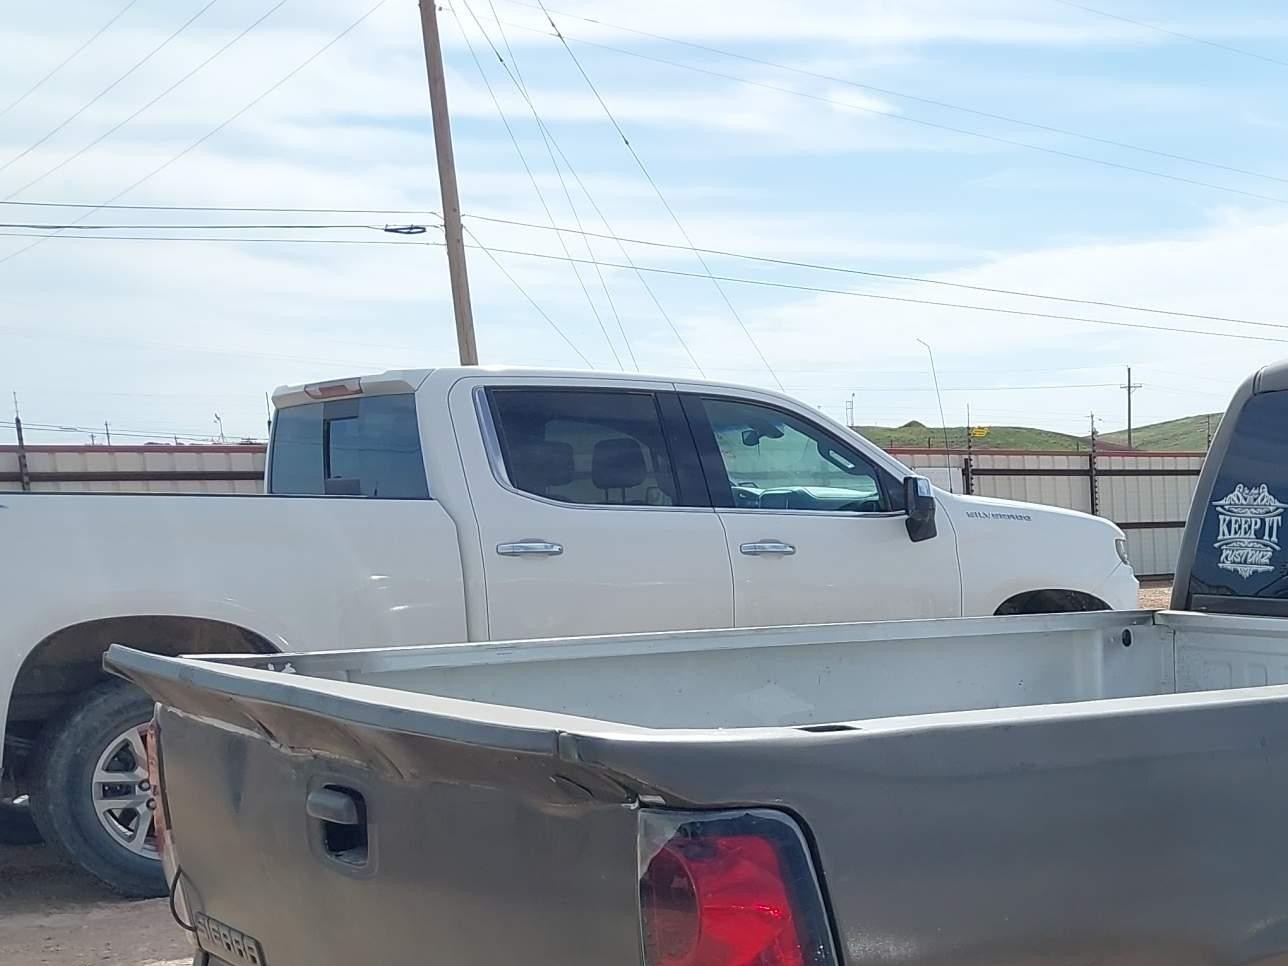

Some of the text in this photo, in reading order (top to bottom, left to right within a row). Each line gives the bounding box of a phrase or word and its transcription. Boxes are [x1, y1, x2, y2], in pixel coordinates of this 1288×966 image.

[1217, 514, 1282, 543] KEEP IT
[1220, 549, 1273, 564] KUSTOMZ
